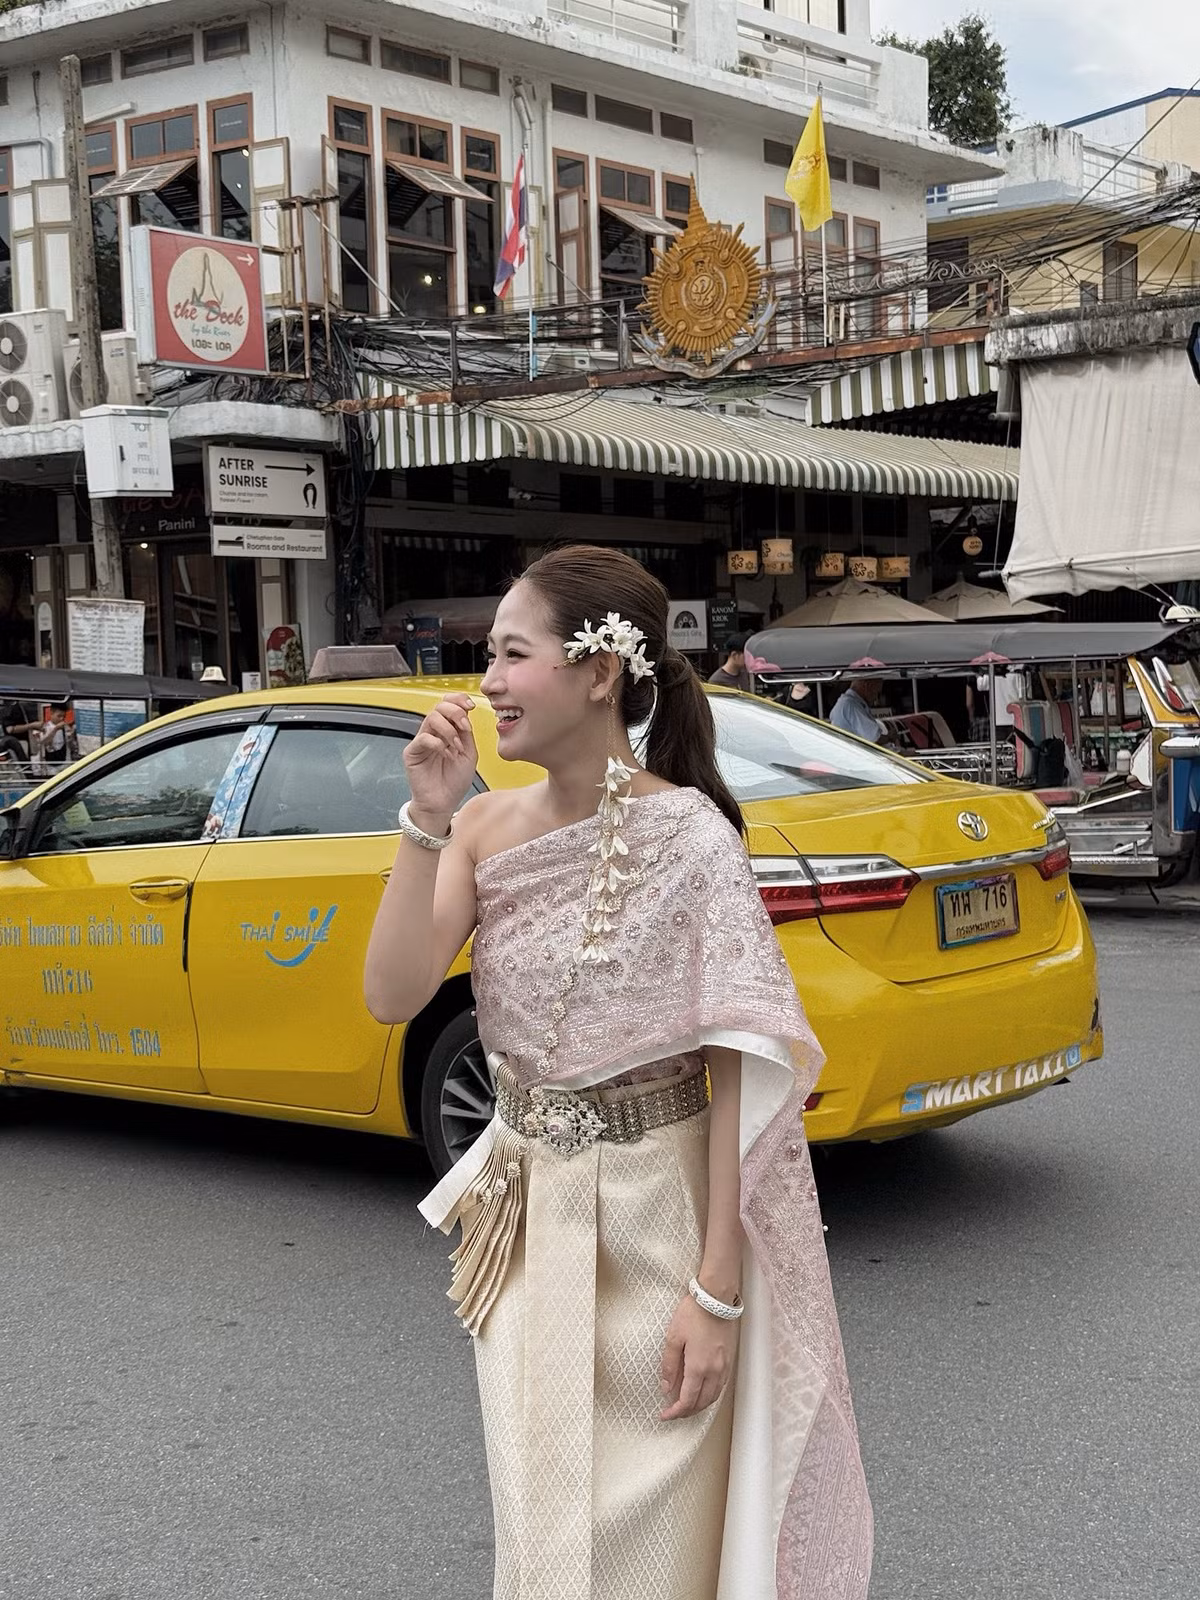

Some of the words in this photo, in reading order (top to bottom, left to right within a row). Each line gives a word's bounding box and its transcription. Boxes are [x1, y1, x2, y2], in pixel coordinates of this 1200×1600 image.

[174, 299, 199, 321] the
[205, 300, 245, 327] Deck
[218, 457, 255, 471] AFTER
[218, 473, 268, 488] SUNRISE
[158, 517, 196, 531] Panini
[246, 543, 271, 551] Rooms
[271, 543, 286, 552] and
[286, 544, 323, 553] Restaurant
[711, 607, 735, 615] KANOM
[982, 884, 1007, 911] 716
[902, 1064, 1008, 1114] SMART
[1014, 1051, 1064, 1090] TAXI
